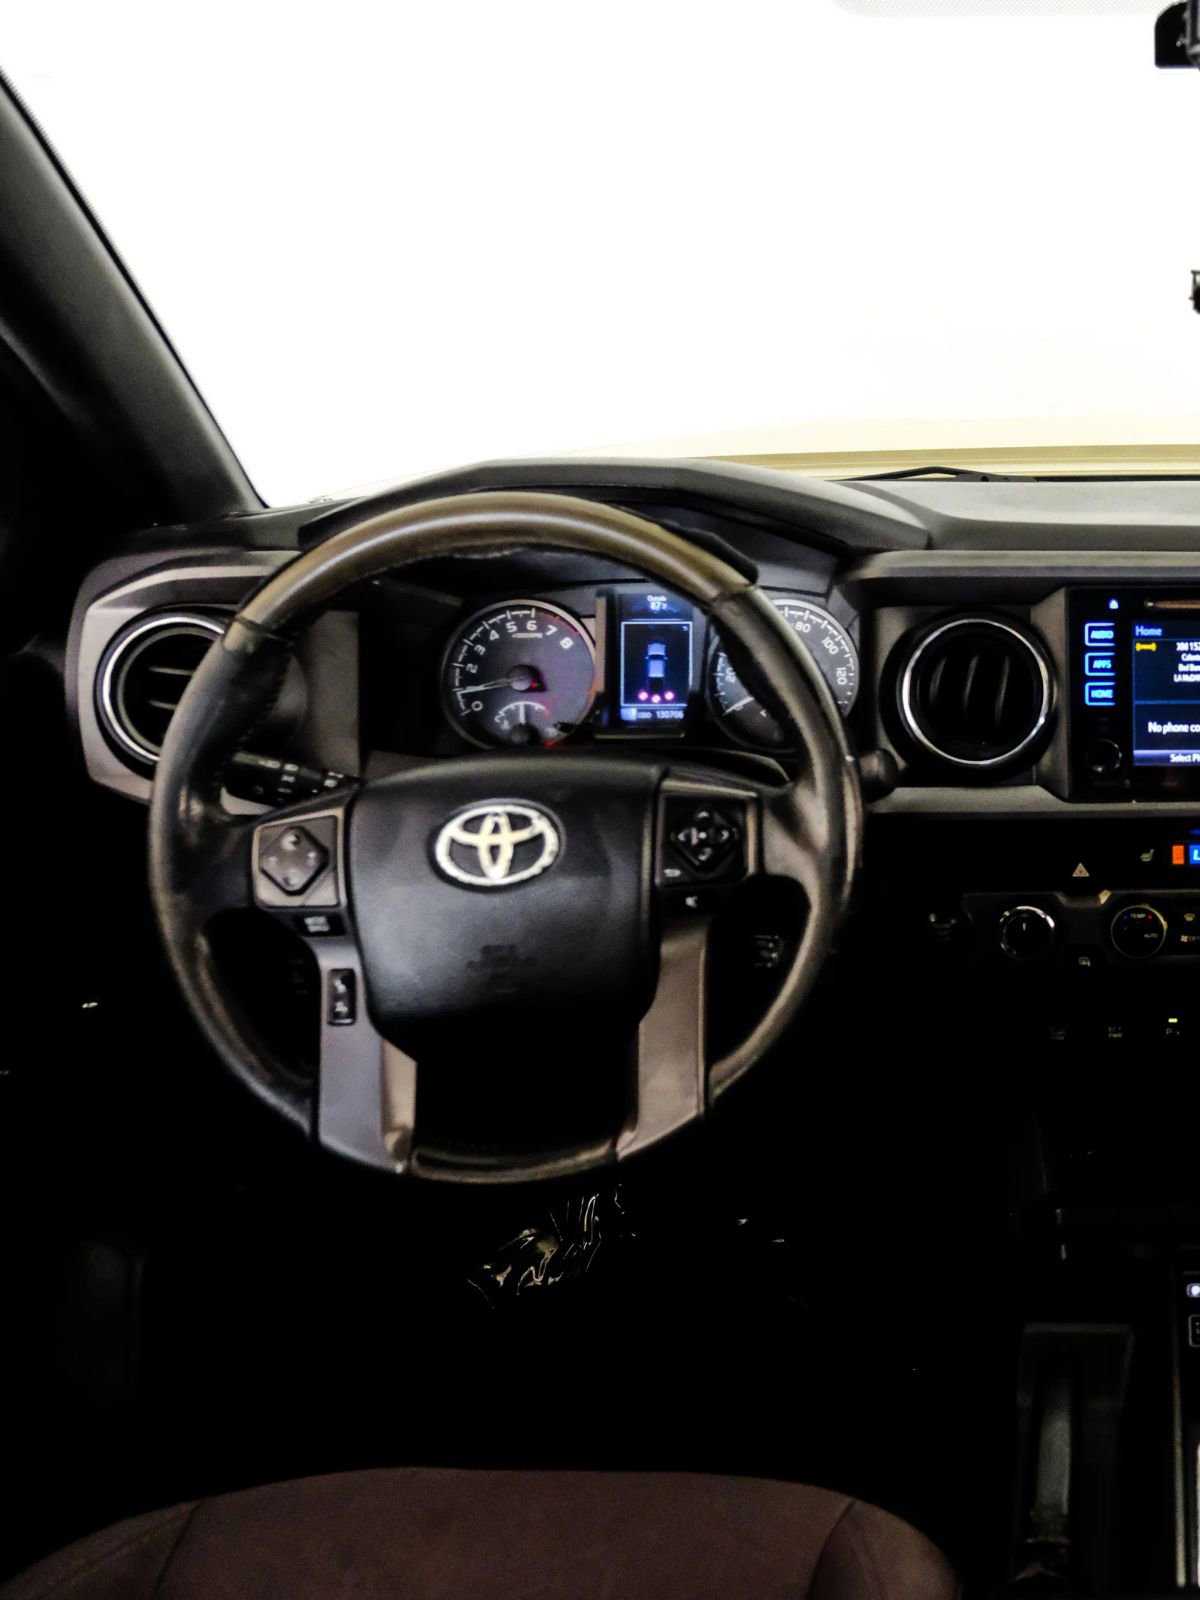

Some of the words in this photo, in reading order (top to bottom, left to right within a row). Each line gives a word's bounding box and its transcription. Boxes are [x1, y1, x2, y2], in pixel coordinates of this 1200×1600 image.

[505, 621, 518, 633] 5
[526, 620, 537, 631] 6
[545, 624, 558, 636] 7
[795, 621, 811, 633] 80
[1135, 625, 1162, 636] Home
[489, 629, 500, 641] 4
[559, 636, 574, 649] 8
[821, 635, 839, 655] 100
[473, 644, 487, 656] 3
[466, 663, 478, 674] 2
[1093, 659, 1112, 669] APPS
[836, 666, 848, 686] 120
[1090, 689, 1113, 698] HOME
[471, 701, 483, 712] 0
[655, 710, 684, 720] 130706
[1148, 721, 1162, 733] No
[1162, 721, 1189, 735] phone
